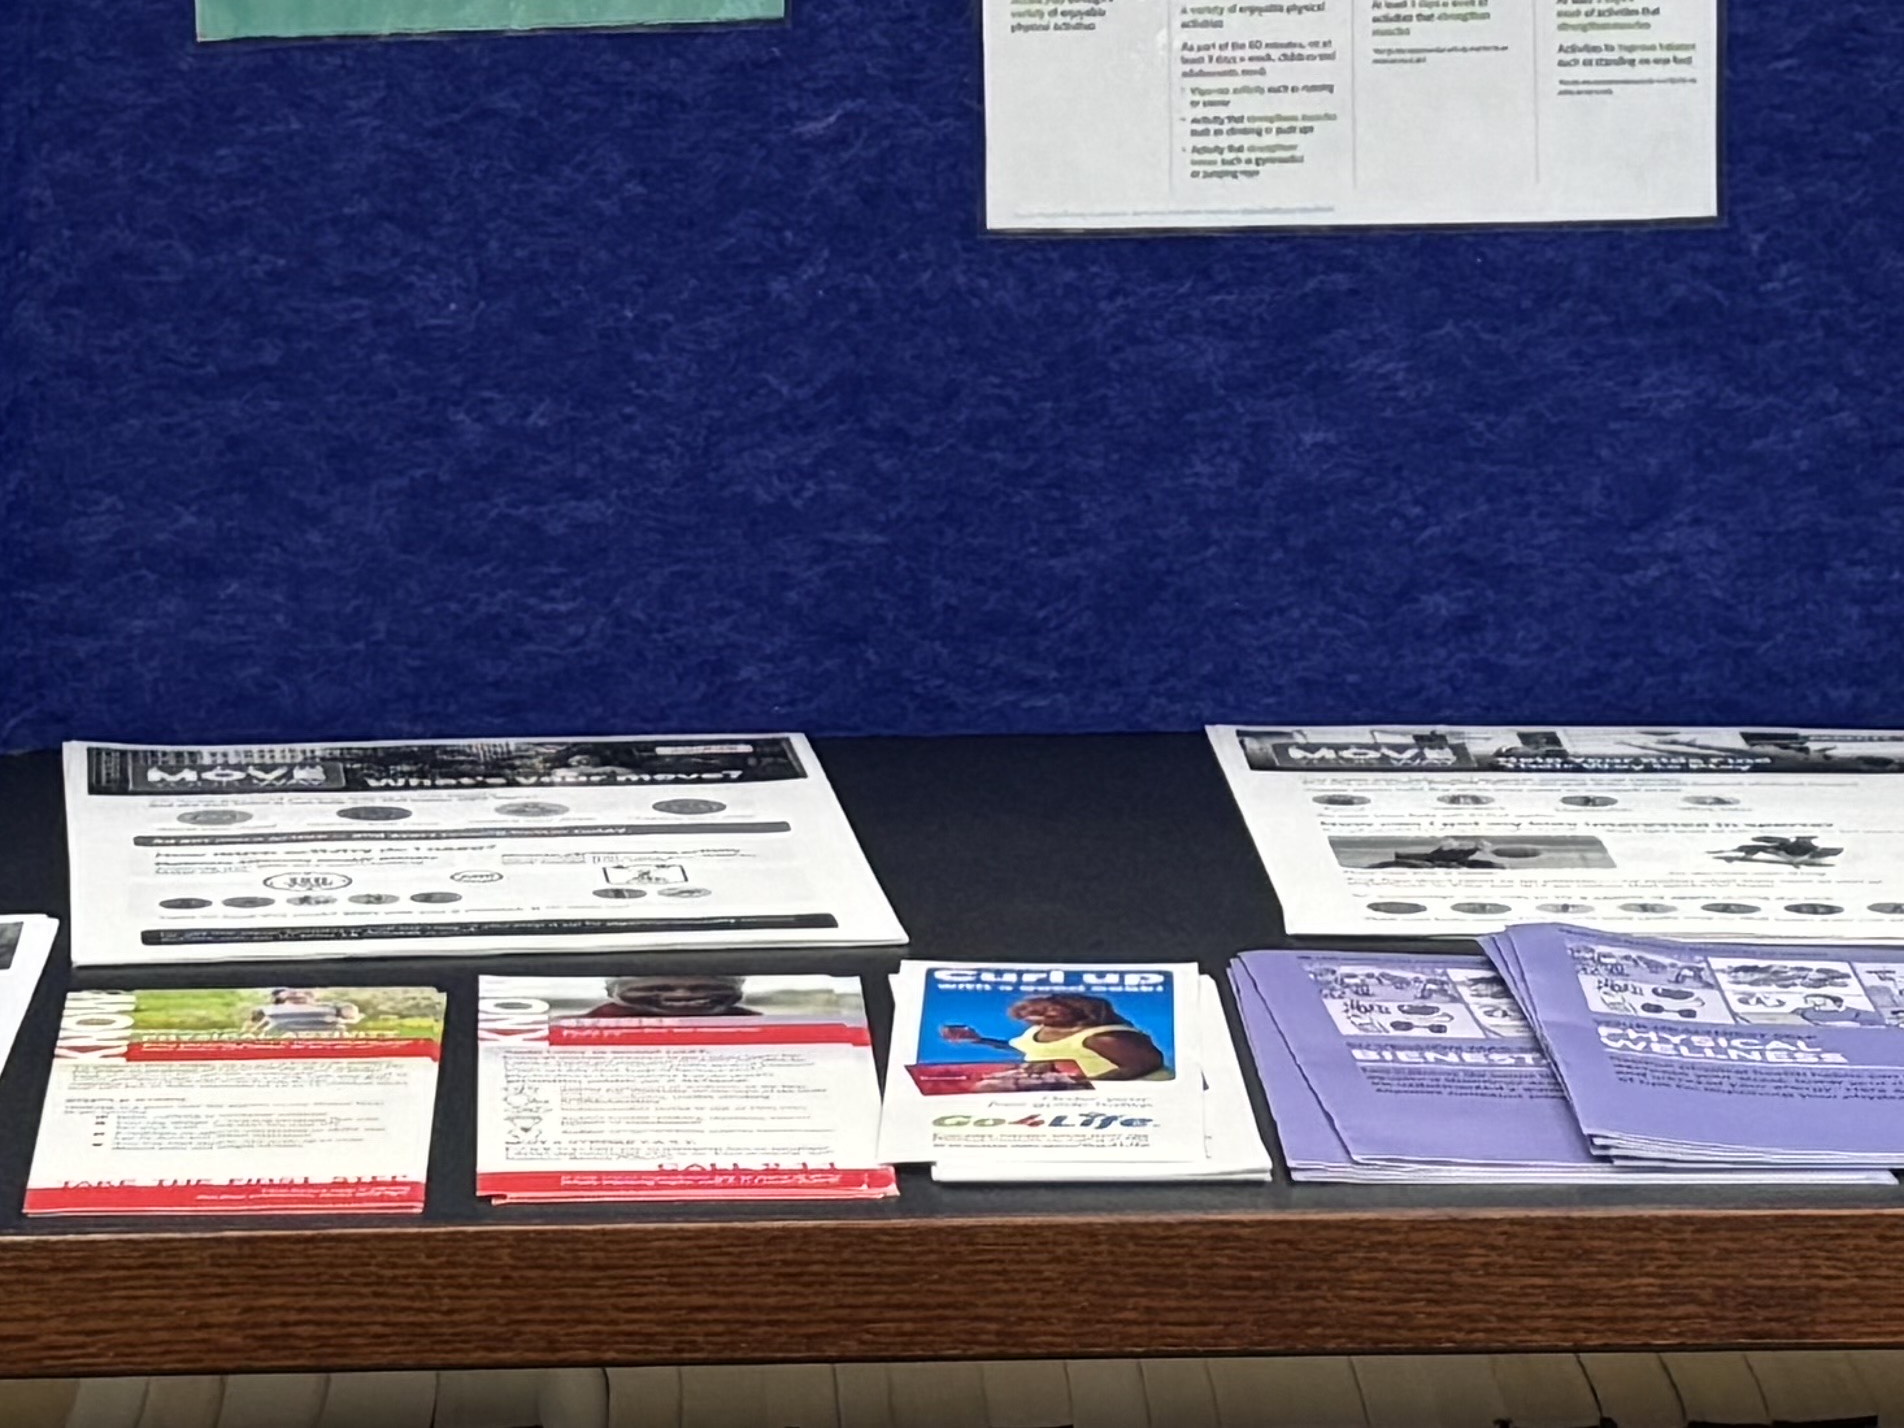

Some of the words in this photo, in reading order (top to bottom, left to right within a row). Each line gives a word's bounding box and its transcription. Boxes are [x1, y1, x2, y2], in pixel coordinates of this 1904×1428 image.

[933, 969, 1066, 985] Curl
[1082, 970, 1166, 986] up
[1597, 1026, 1824, 1053] PHYSICAL
[1600, 1035, 1848, 1064] WELLNESS
